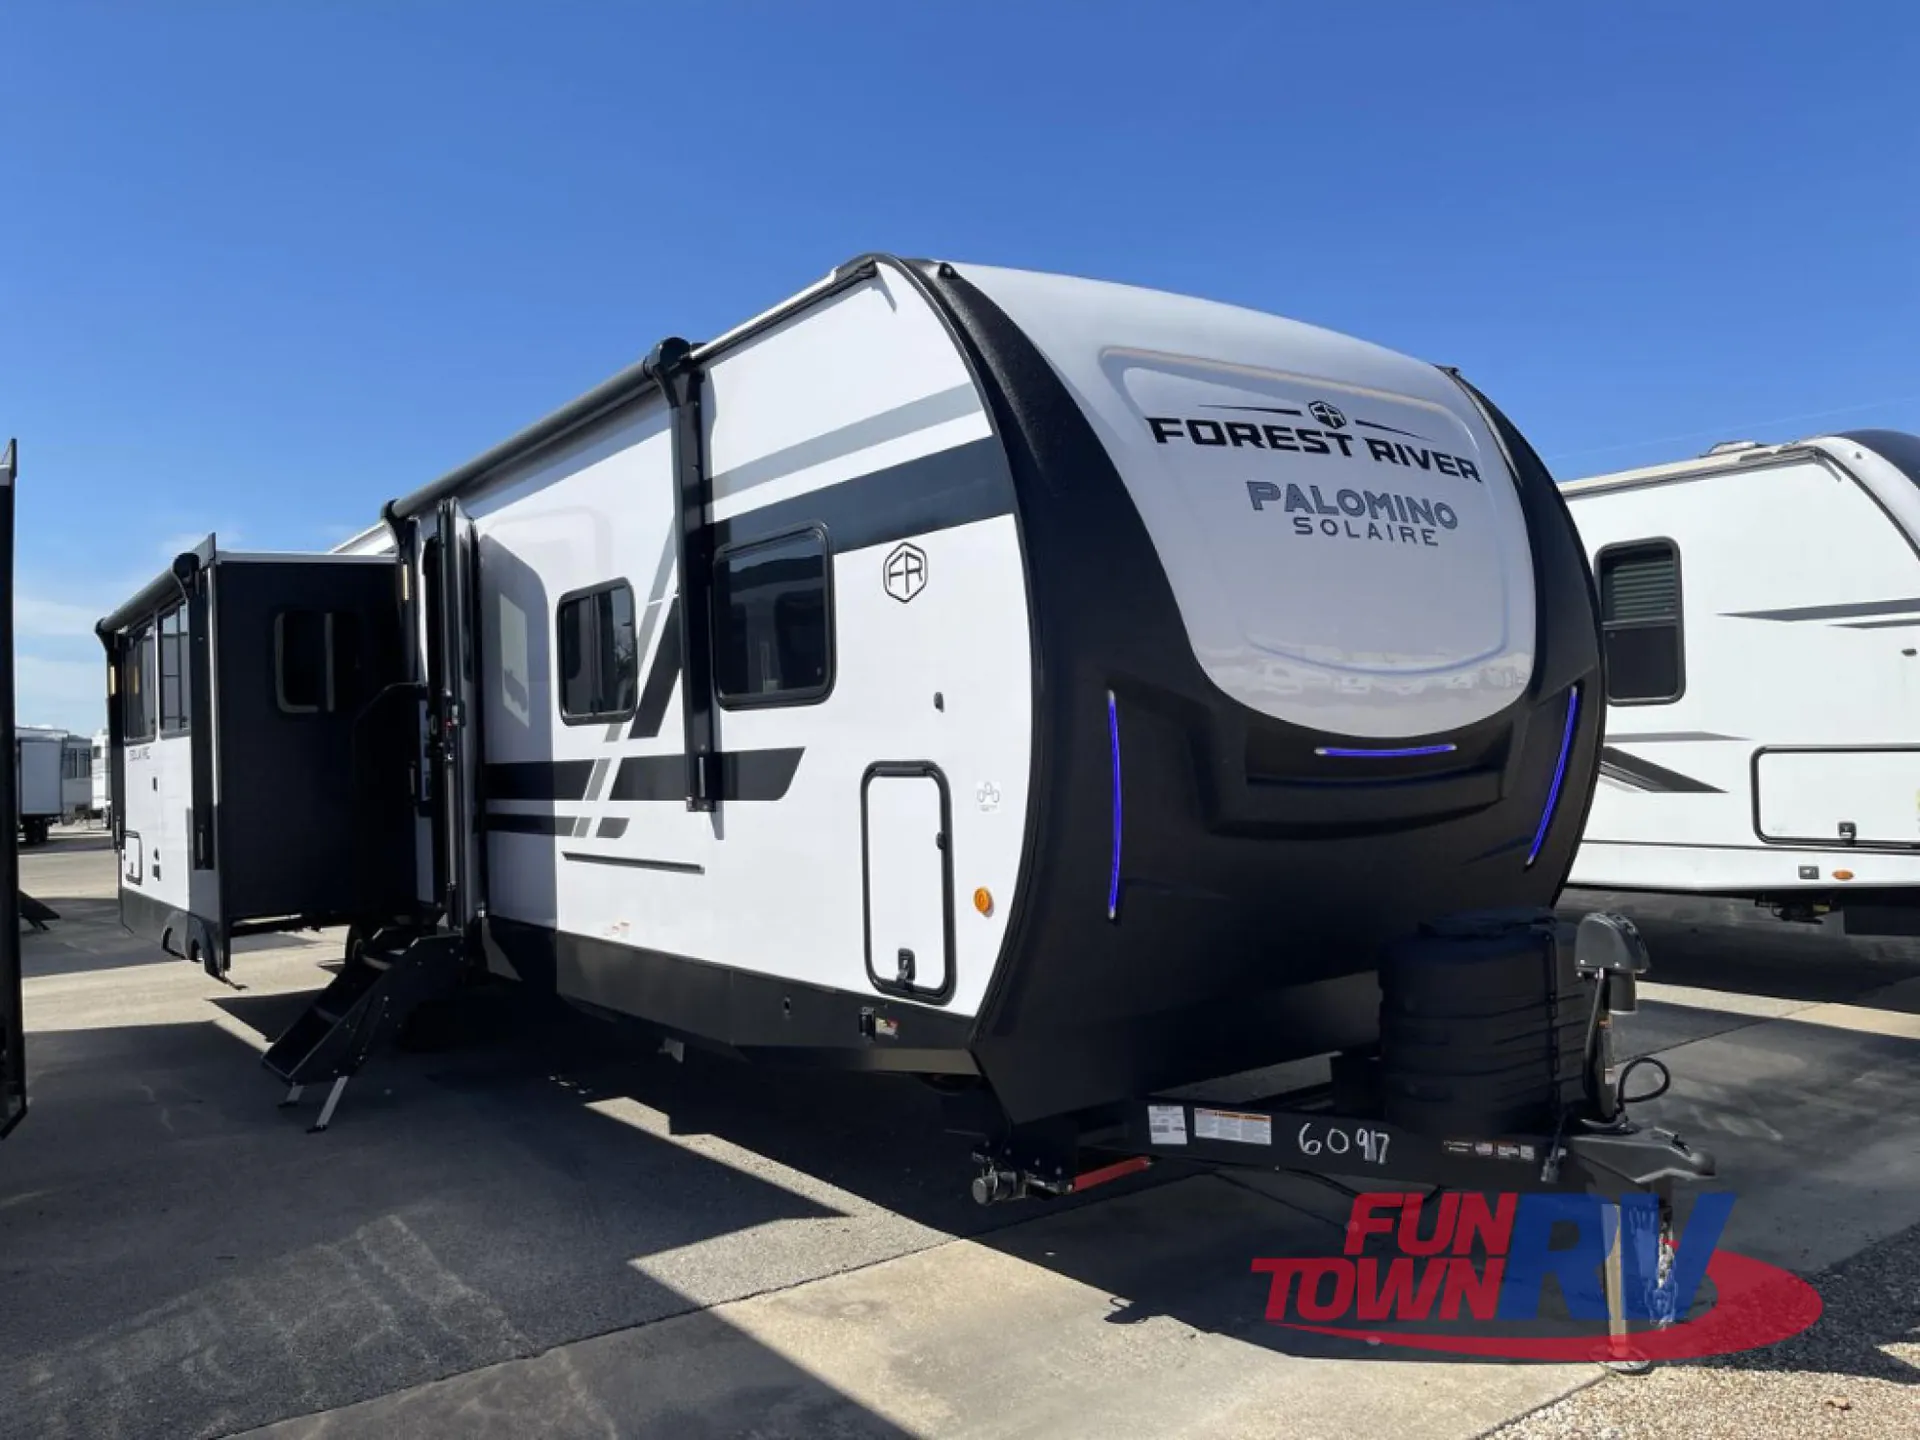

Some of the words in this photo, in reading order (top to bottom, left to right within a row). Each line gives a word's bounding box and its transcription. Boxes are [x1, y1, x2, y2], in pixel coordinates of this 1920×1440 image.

[1146, 416, 1353, 457] FOREST
[1364, 437, 1483, 483] RIVER
[1246, 480, 1460, 531] PALOMINO
[1294, 516, 1439, 547] SOLAIRE
